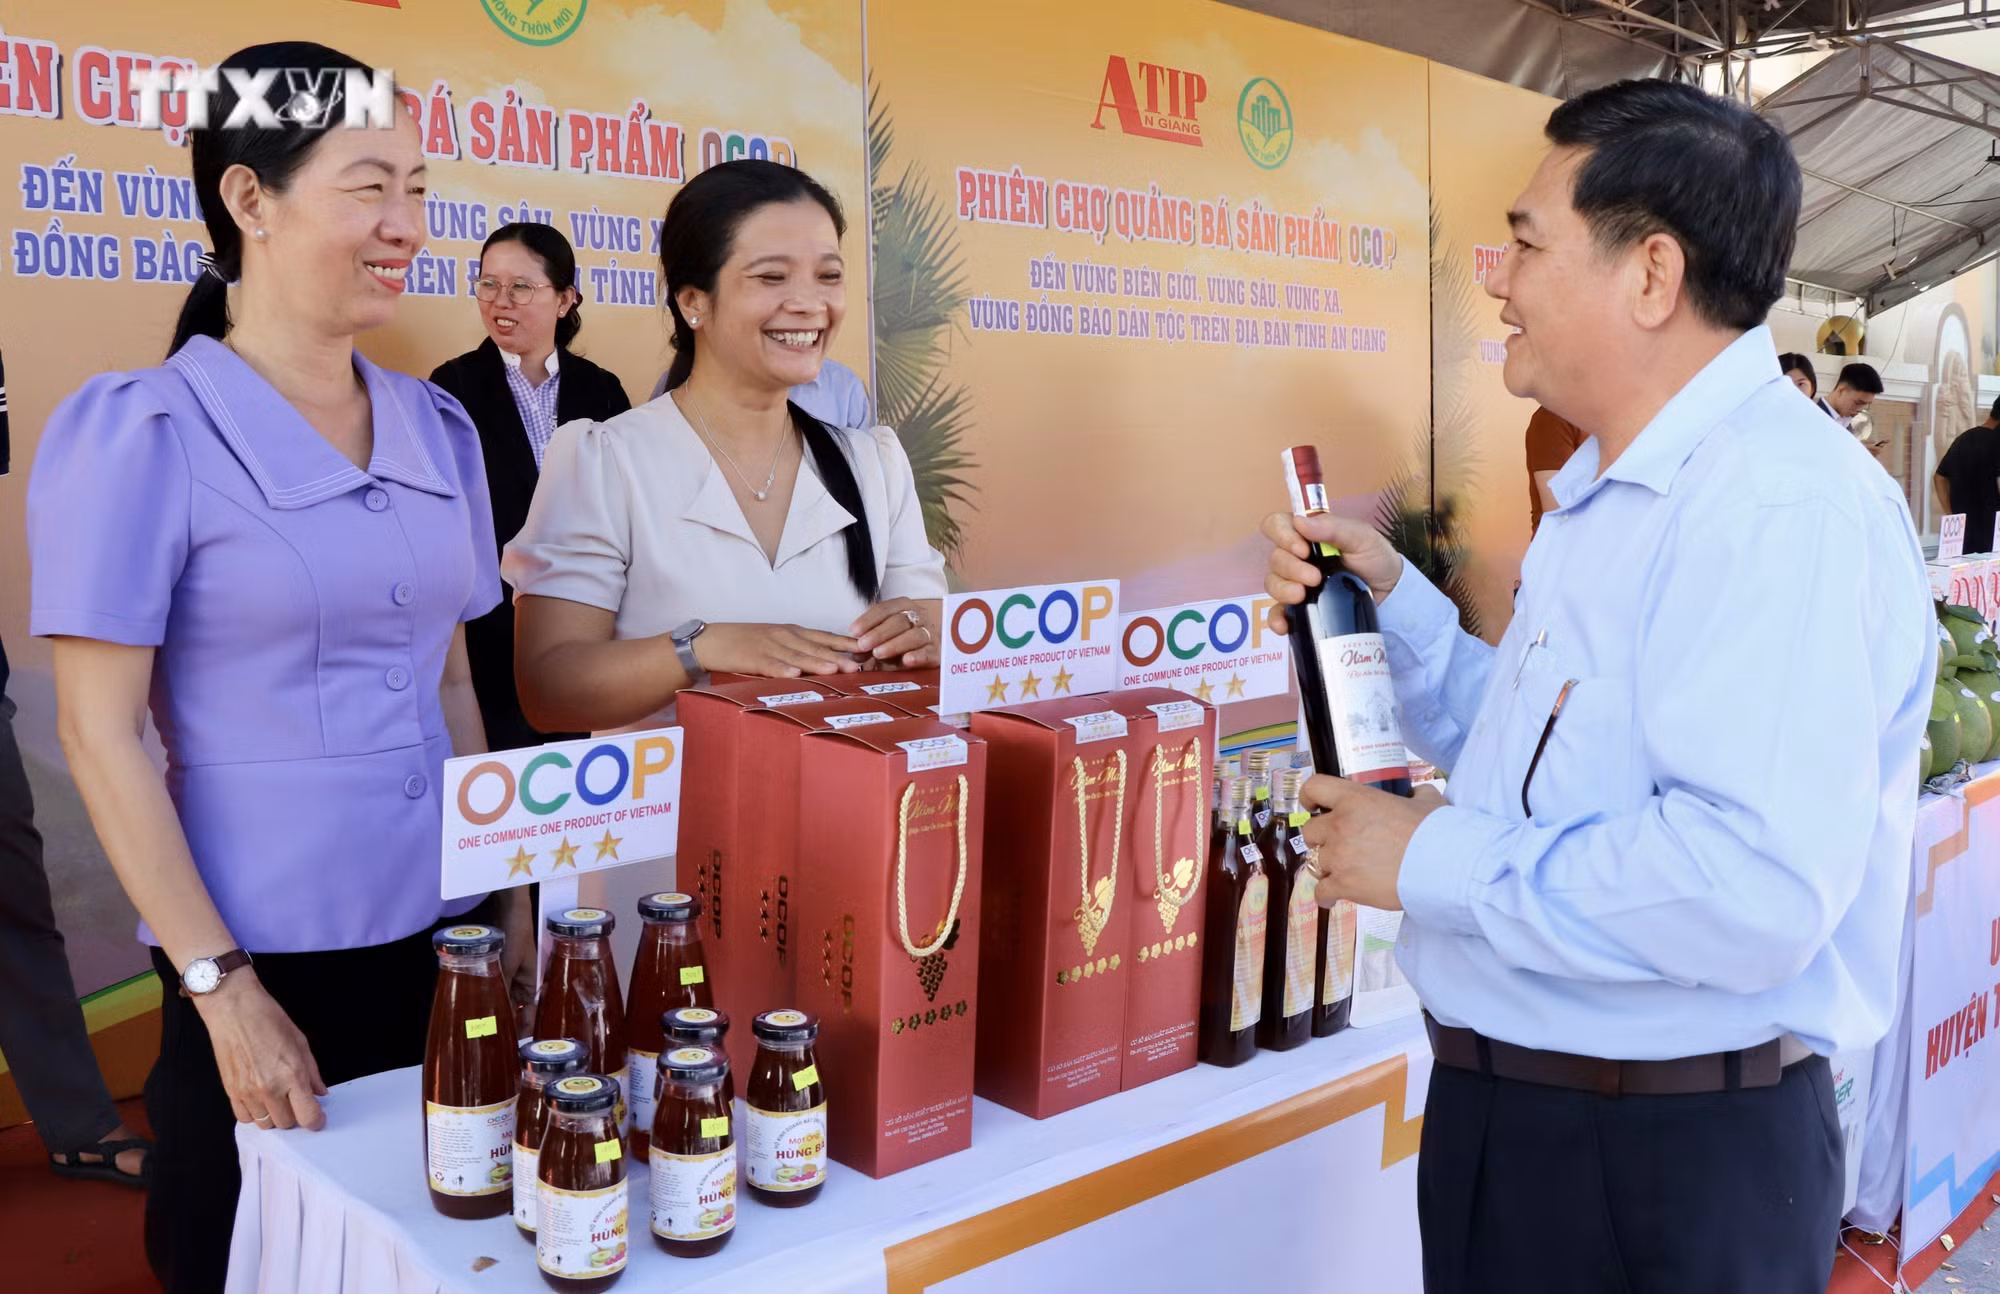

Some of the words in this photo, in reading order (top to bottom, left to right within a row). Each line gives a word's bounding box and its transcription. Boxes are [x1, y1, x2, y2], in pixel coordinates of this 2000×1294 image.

[521, 20, 552, 35] THÔN
[1090, 55, 1207, 147] ATIP
[1158, 117, 1200, 134] GIANG
[470, 89, 553, 166] SẢN
[569, 102, 680, 179] PHẨM
[23, 156, 102, 213] ĐẾN
[117, 168, 206, 221] VÙN
[959, 167, 1045, 225] PHIÊN
[1055, 183, 1107, 241] CHỢ
[1115, 185, 1192, 243] QUẢNG
[1200, 198, 1230, 247] BÁ
[1236, 201, 1277, 252] SẢN
[1284, 206, 1339, 260] PHẨM
[1350, 225, 1394, 266] OCOP
[14, 218, 119, 279] ĐỒNG
[570, 207, 641, 253] VÙNG
[591, 259, 656, 305] TỈNH
[1030, 254, 1066, 290] ĐẾN
[1072, 259, 1117, 294] VÙNG
[1123, 265, 1161, 297] BIÊN
[1167, 268, 1202, 303] GIỚI,
[1207, 273, 1245, 305] VÙNG
[1250, 278, 1281, 310] SÂU,
[969, 293, 1020, 331] VÙNG
[1025, 294, 1073, 333] ĐỒNG
[1080, 301, 1112, 336] BÀO
[1118, 304, 1150, 338] DÂN
[1155, 308, 1185, 345] TỘC
[1190, 311, 1230, 343] TRÊN
[1235, 318, 1260, 349] ĐỊA
[1331, 326, 1347, 350] AN
[1351, 327, 1386, 353] GIANG
[951, 585, 1113, 655] OCOP
[1122, 598, 1273, 667] OCOP
[951, 663, 968, 675] ONE
[970, 658, 1010, 672] COMMUNE
[1012, 654, 1028, 666] ONE
[1030, 650, 1065, 664] PRODUCT
[1067, 648, 1077, 660] OF
[1079, 645, 1111, 658] VIETNAM
[1124, 674, 1141, 687] ONE
[1143, 668, 1182, 683] COMMUNE
[1184, 665, 1200, 677] ONE
[1202, 659, 1237, 674] PRODUCT
[1239, 657, 1249, 668] OF
[1251, 652, 1283, 665] VIETNAM
[457, 735, 674, 825] OCOP
[458, 835, 481, 850] ONE
[484, 825, 537, 845] COMMUNE
[540, 821, 562, 835] ONE
[564, 812, 612, 831] PRODUCT
[614, 809, 627, 822] OF
[630, 802, 671, 820] VIETNAM
[1925, 991, 1988, 1080] HUYỆN
[776, 1148, 812, 1160] HÙNG
[699, 1187, 731, 1205] HÙNG
[591, 1223, 624, 1243] HÙNG
